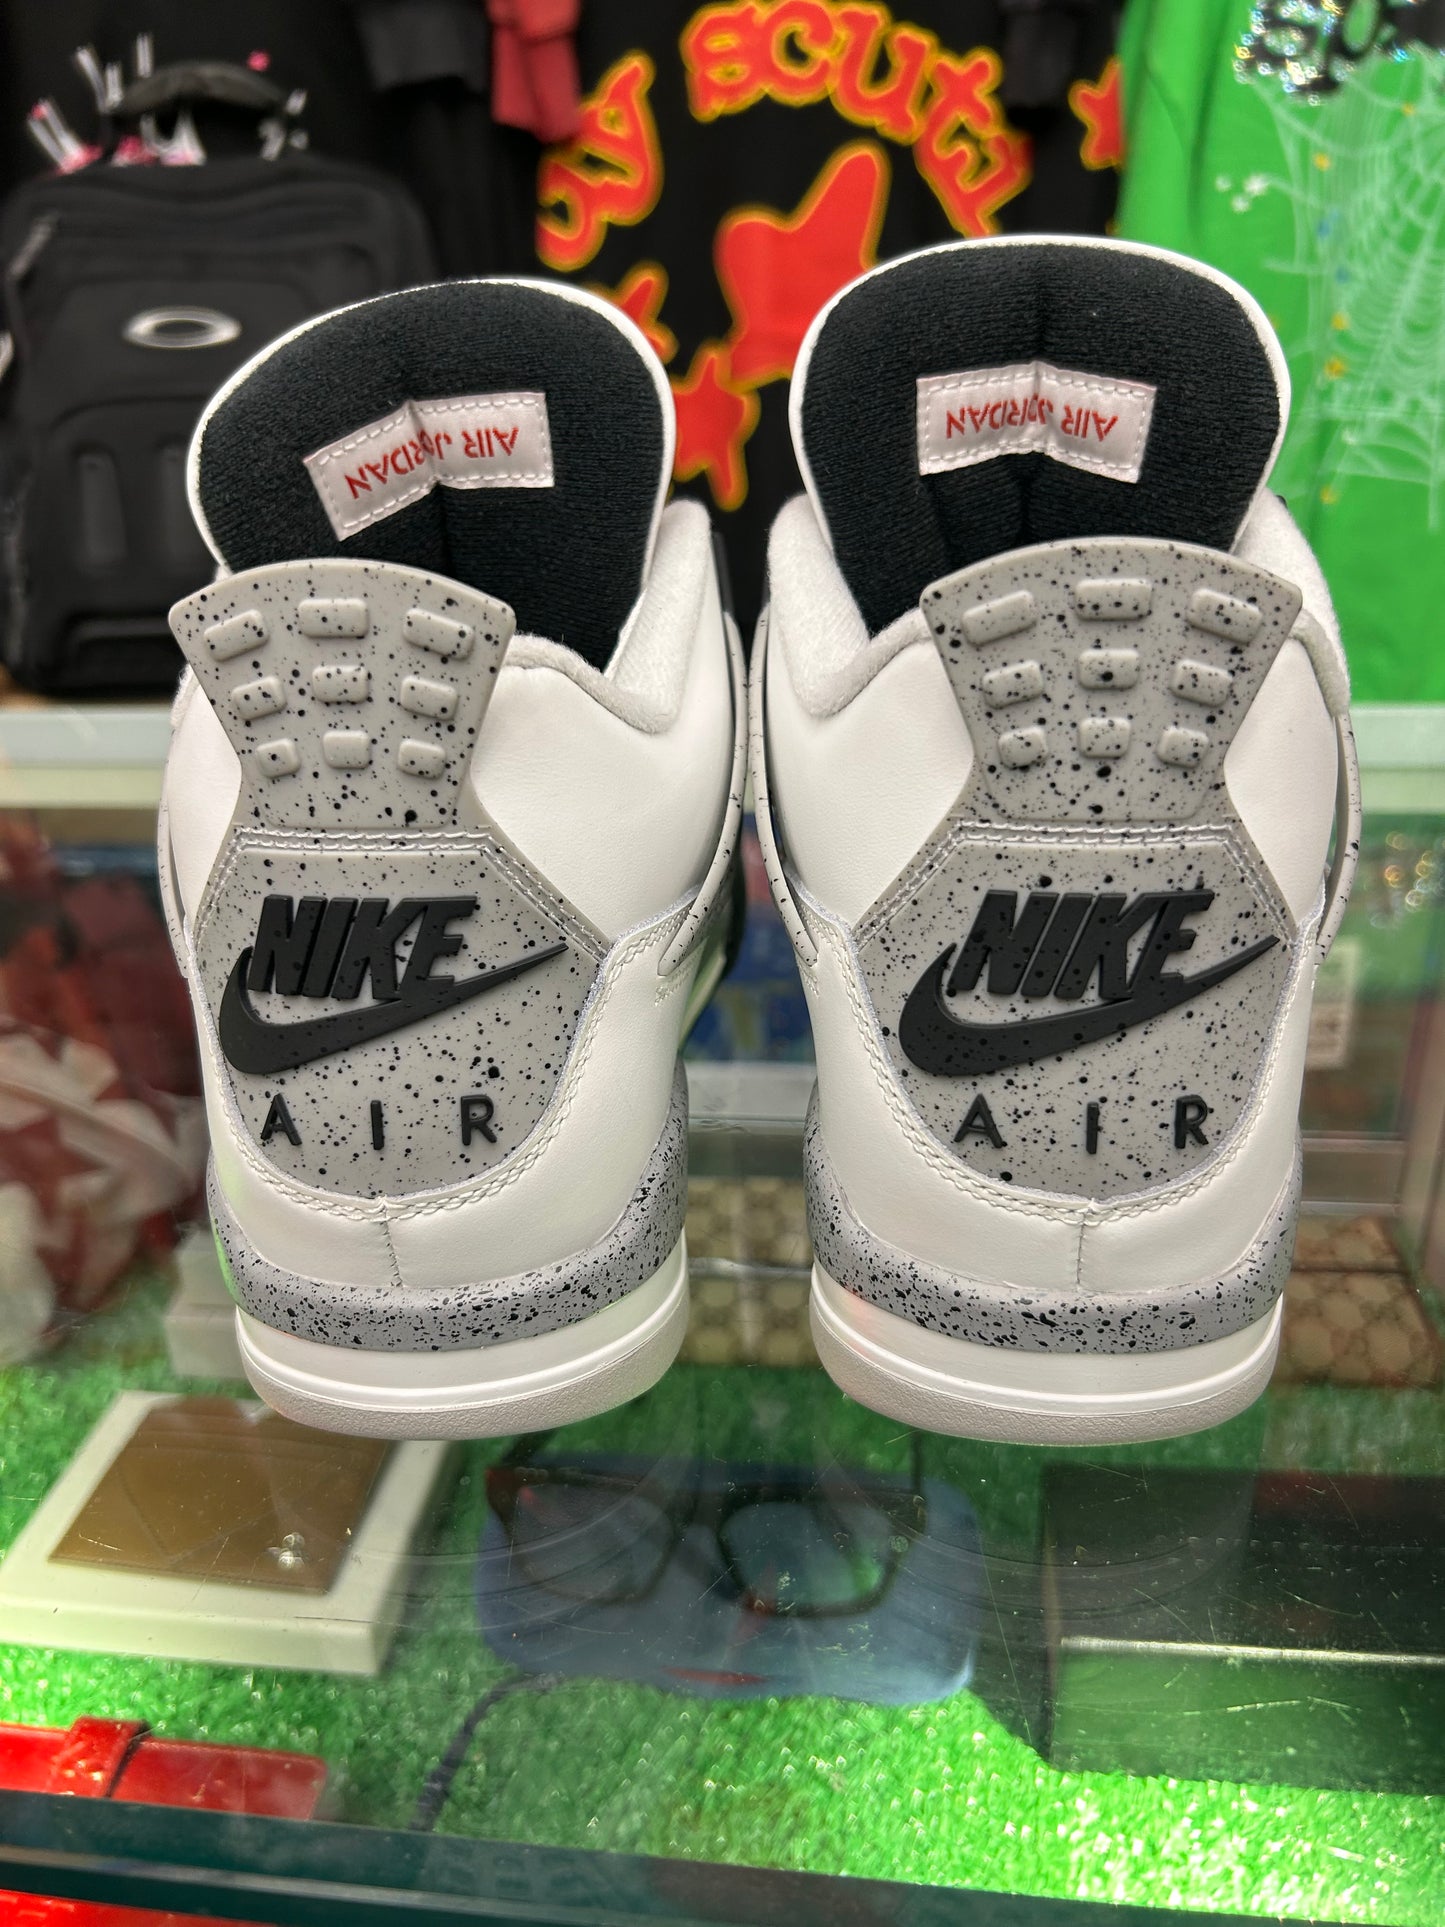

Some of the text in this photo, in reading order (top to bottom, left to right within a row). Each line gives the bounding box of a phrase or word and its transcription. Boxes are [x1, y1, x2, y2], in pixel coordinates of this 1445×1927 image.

[945, 392, 1119, 442] AIR JORDAN
[343, 426, 520, 500] AIR JORDAN
[247, 893, 478, 1001] NIKE
[947, 888, 1215, 1001] NIKE
[260, 1093, 498, 1151] AIR
[953, 1093, 1210, 1155] AIR
